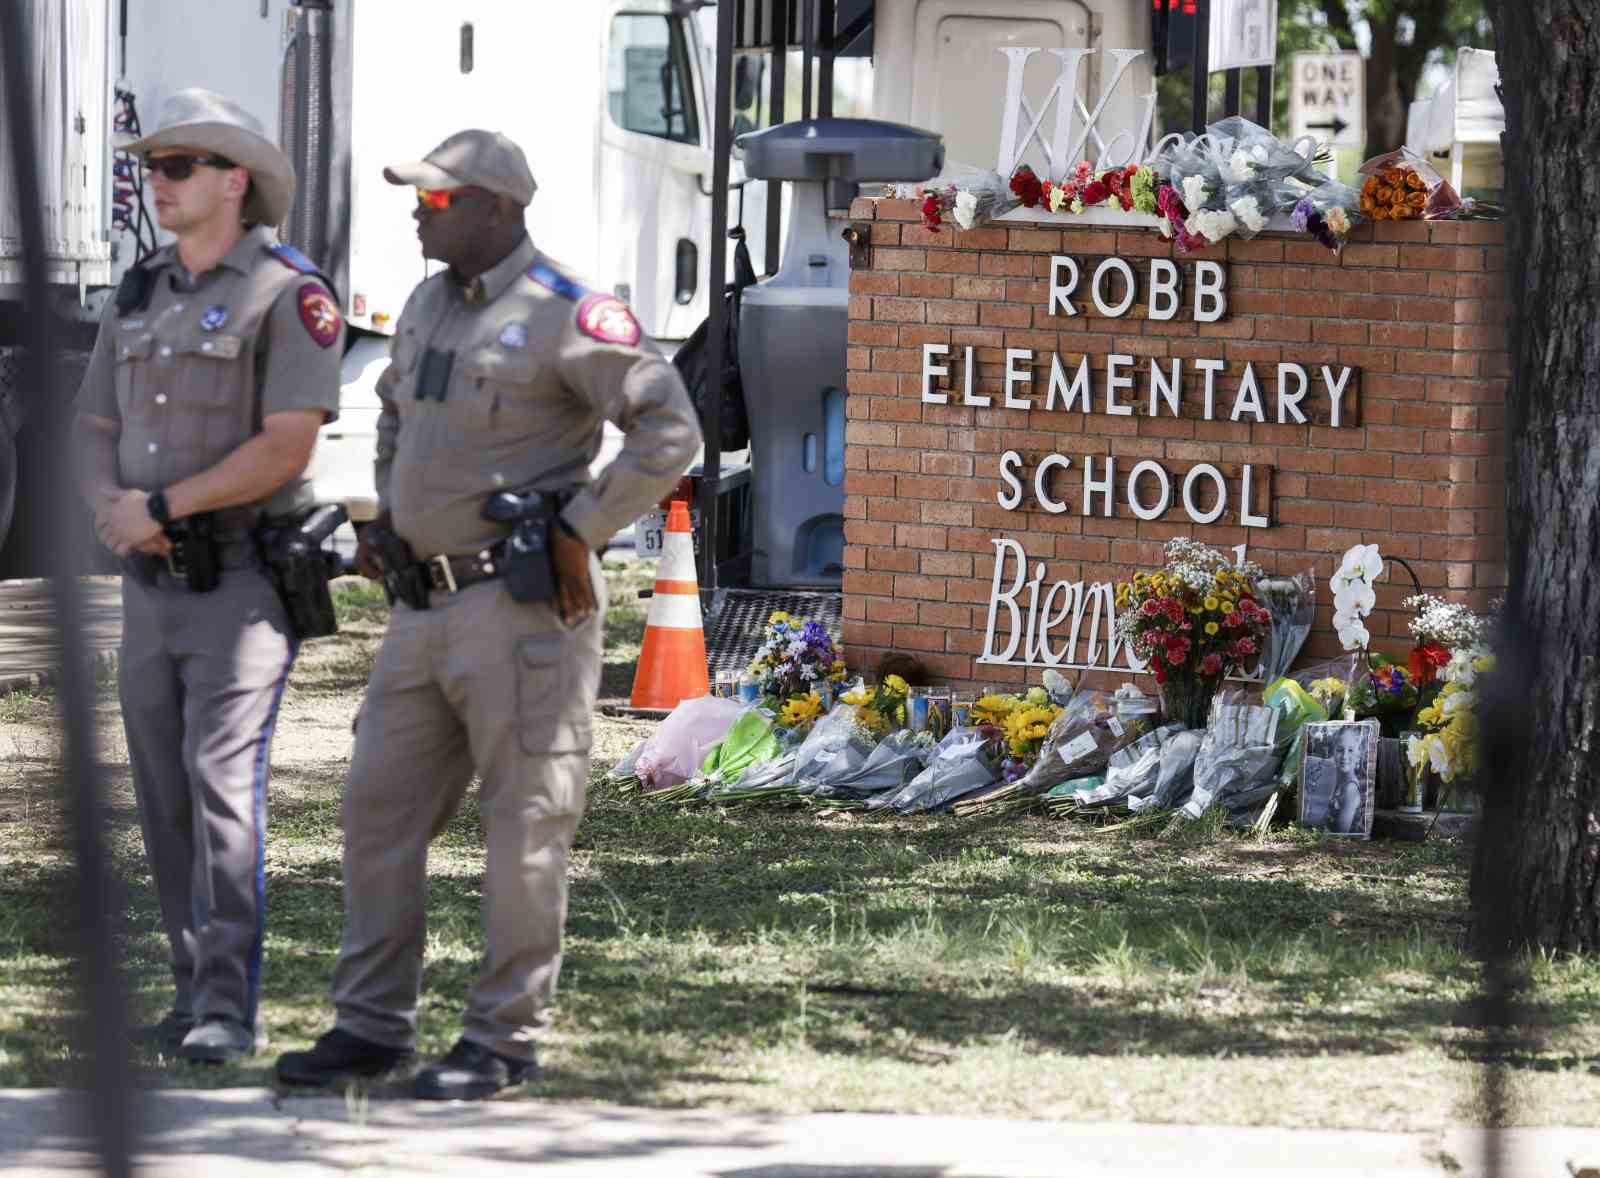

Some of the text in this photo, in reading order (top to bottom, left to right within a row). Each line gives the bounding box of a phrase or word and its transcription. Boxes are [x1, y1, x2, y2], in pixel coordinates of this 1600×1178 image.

[1303, 62, 1353, 82] ONE
[1303, 87, 1354, 106] WAY
[1048, 255, 1226, 322] ROBB
[921, 343, 1352, 427] ELEMENTARY
[997, 450, 1270, 528] SCHOOL
